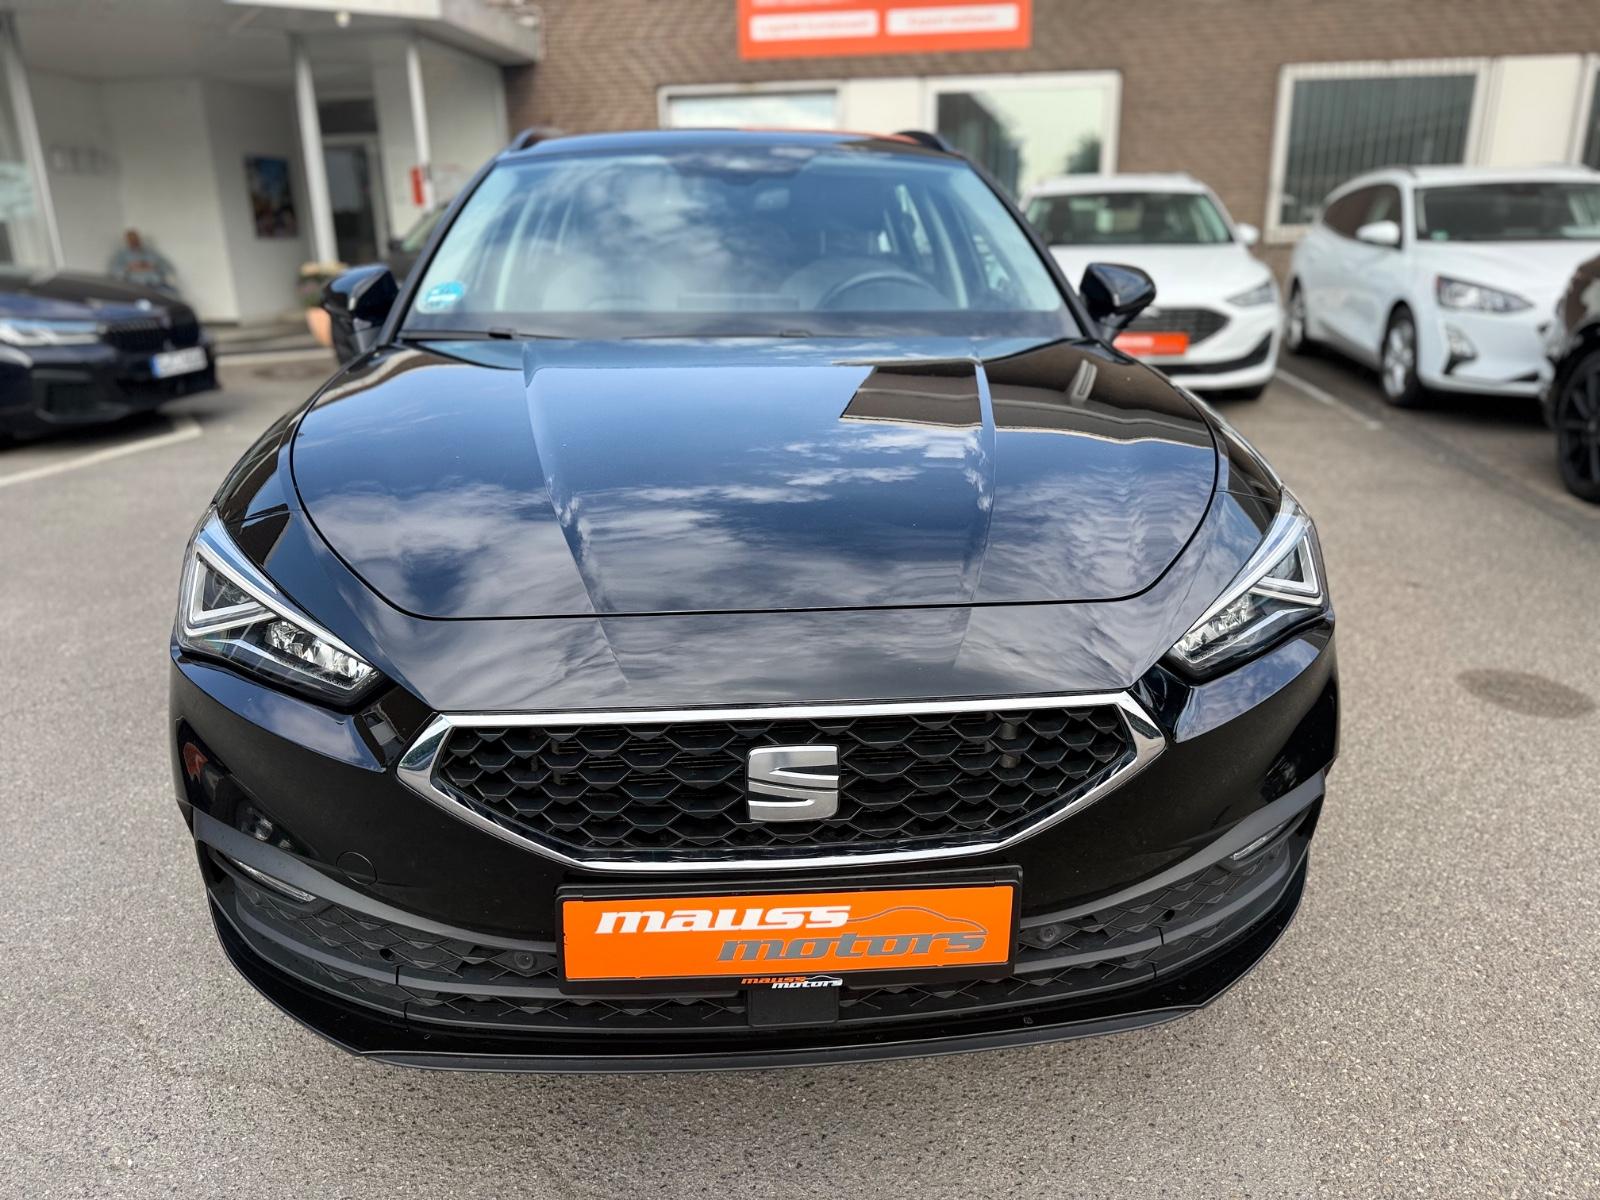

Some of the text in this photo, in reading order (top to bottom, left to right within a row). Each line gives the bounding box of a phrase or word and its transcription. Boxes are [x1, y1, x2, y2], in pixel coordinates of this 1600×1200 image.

[595, 905, 852, 934] mauss
[716, 932, 988, 961] motors
[741, 976, 807, 984] mauss
[771, 979, 843, 989] motors
